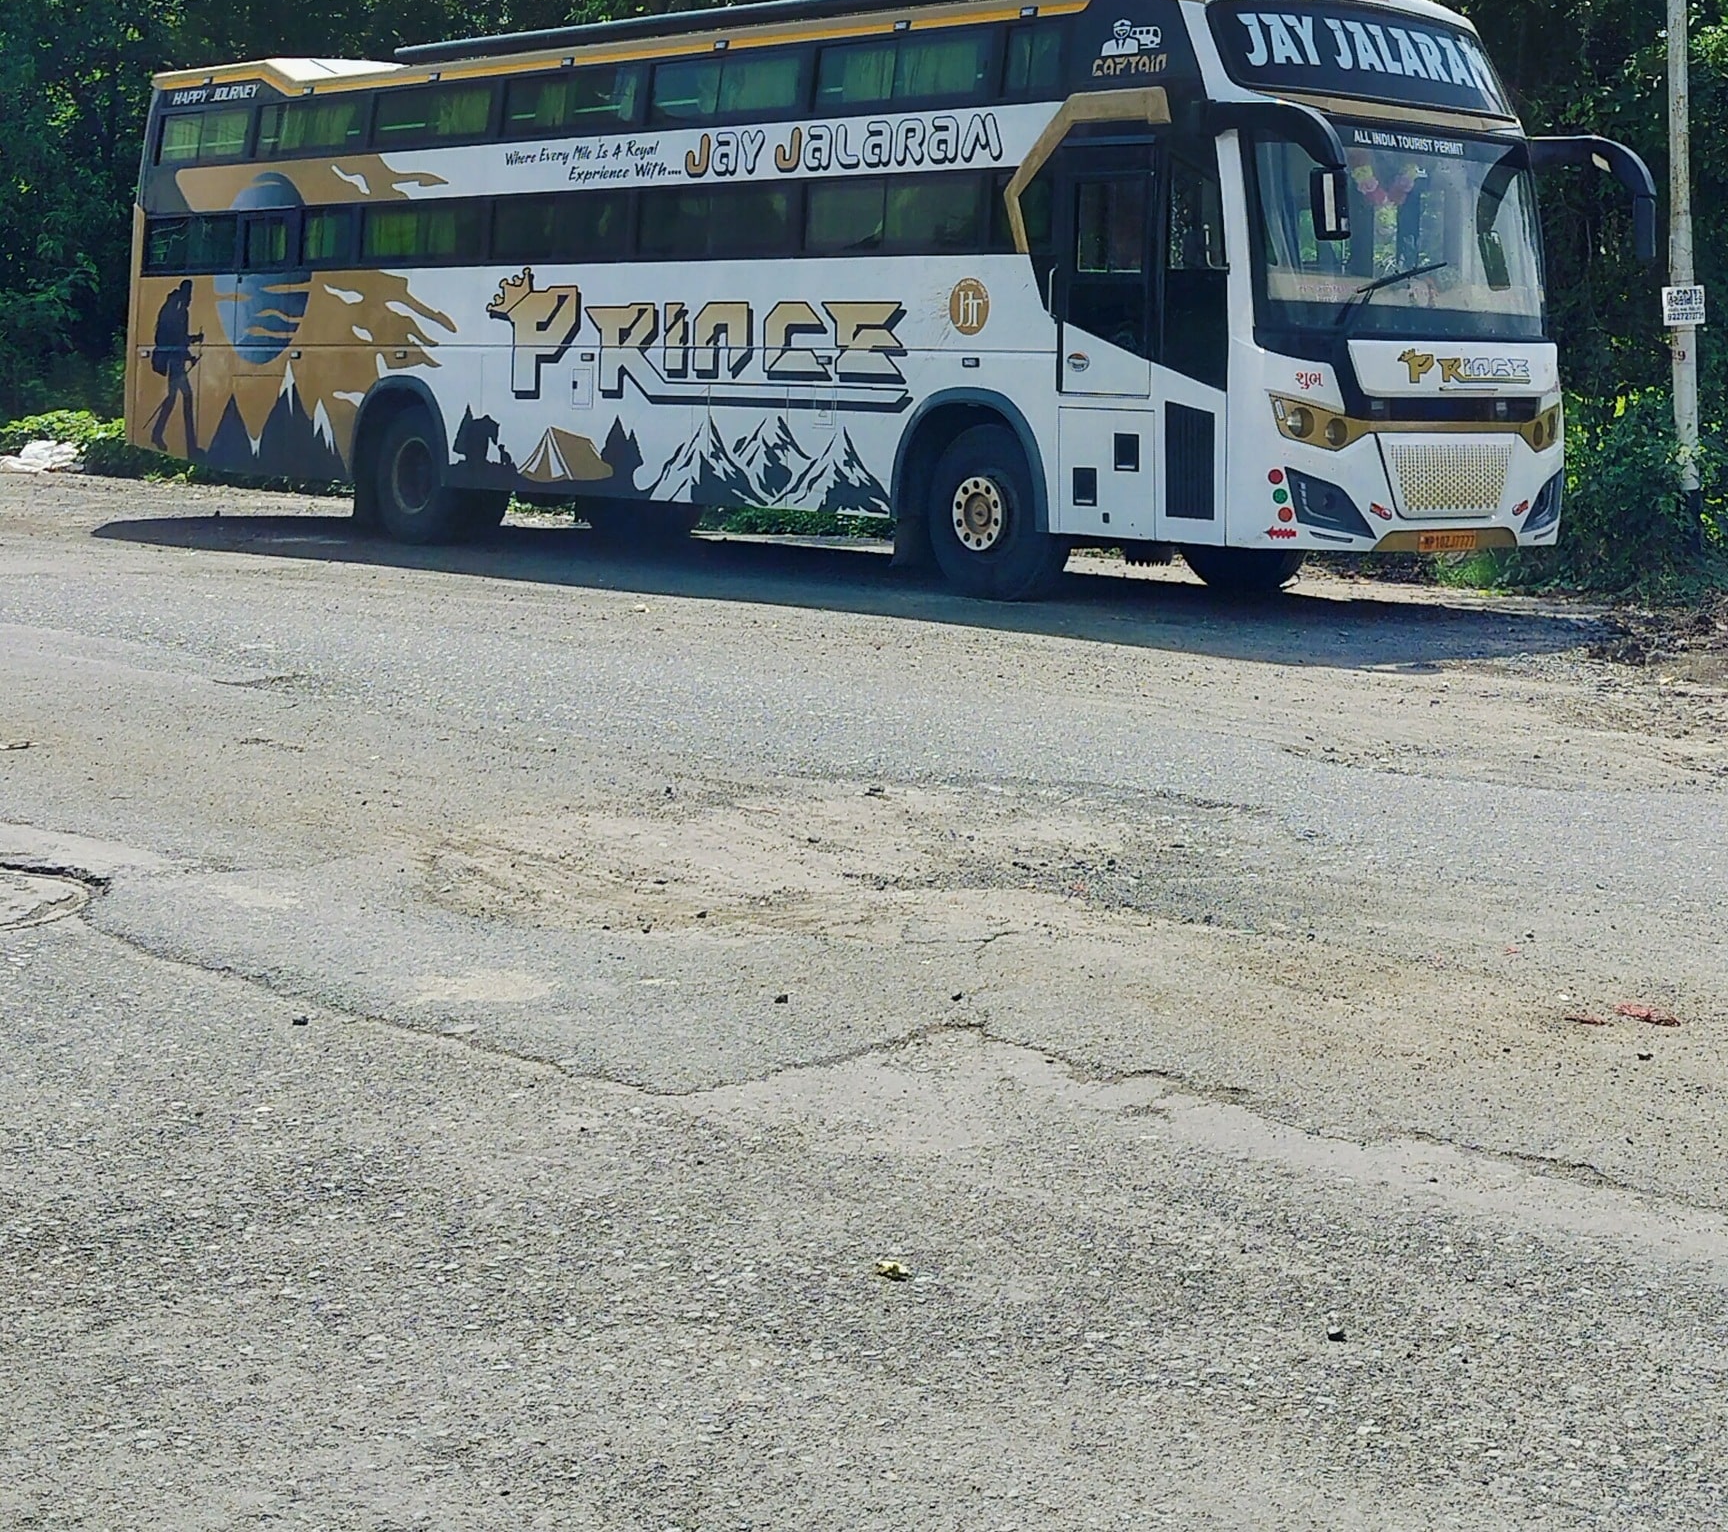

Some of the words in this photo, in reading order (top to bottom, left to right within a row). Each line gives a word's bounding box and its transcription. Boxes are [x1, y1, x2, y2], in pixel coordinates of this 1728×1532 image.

[1236, 13, 1321, 67] JAY
[1092, 53, 1167, 77] CAPTAIN
[172, 89, 209, 105] HAPPY
[210, 84, 260, 102] JOURNEY
[505, 150, 536, 166] Where
[539, 148, 569, 165] Every
[572, 145, 592, 161] Mile
[595, 139, 608, 160] Is
[612, 143, 622, 160] A
[1354, 130, 1371, 144] ALL
[1372, 132, 1397, 148] INDIA
[1396, 135, 1434, 152] TOURIST
[1433, 139, 1464, 156] PERMIT
[568, 166, 630, 184] Exprience
[1295, 372, 1324, 390] શુભ
